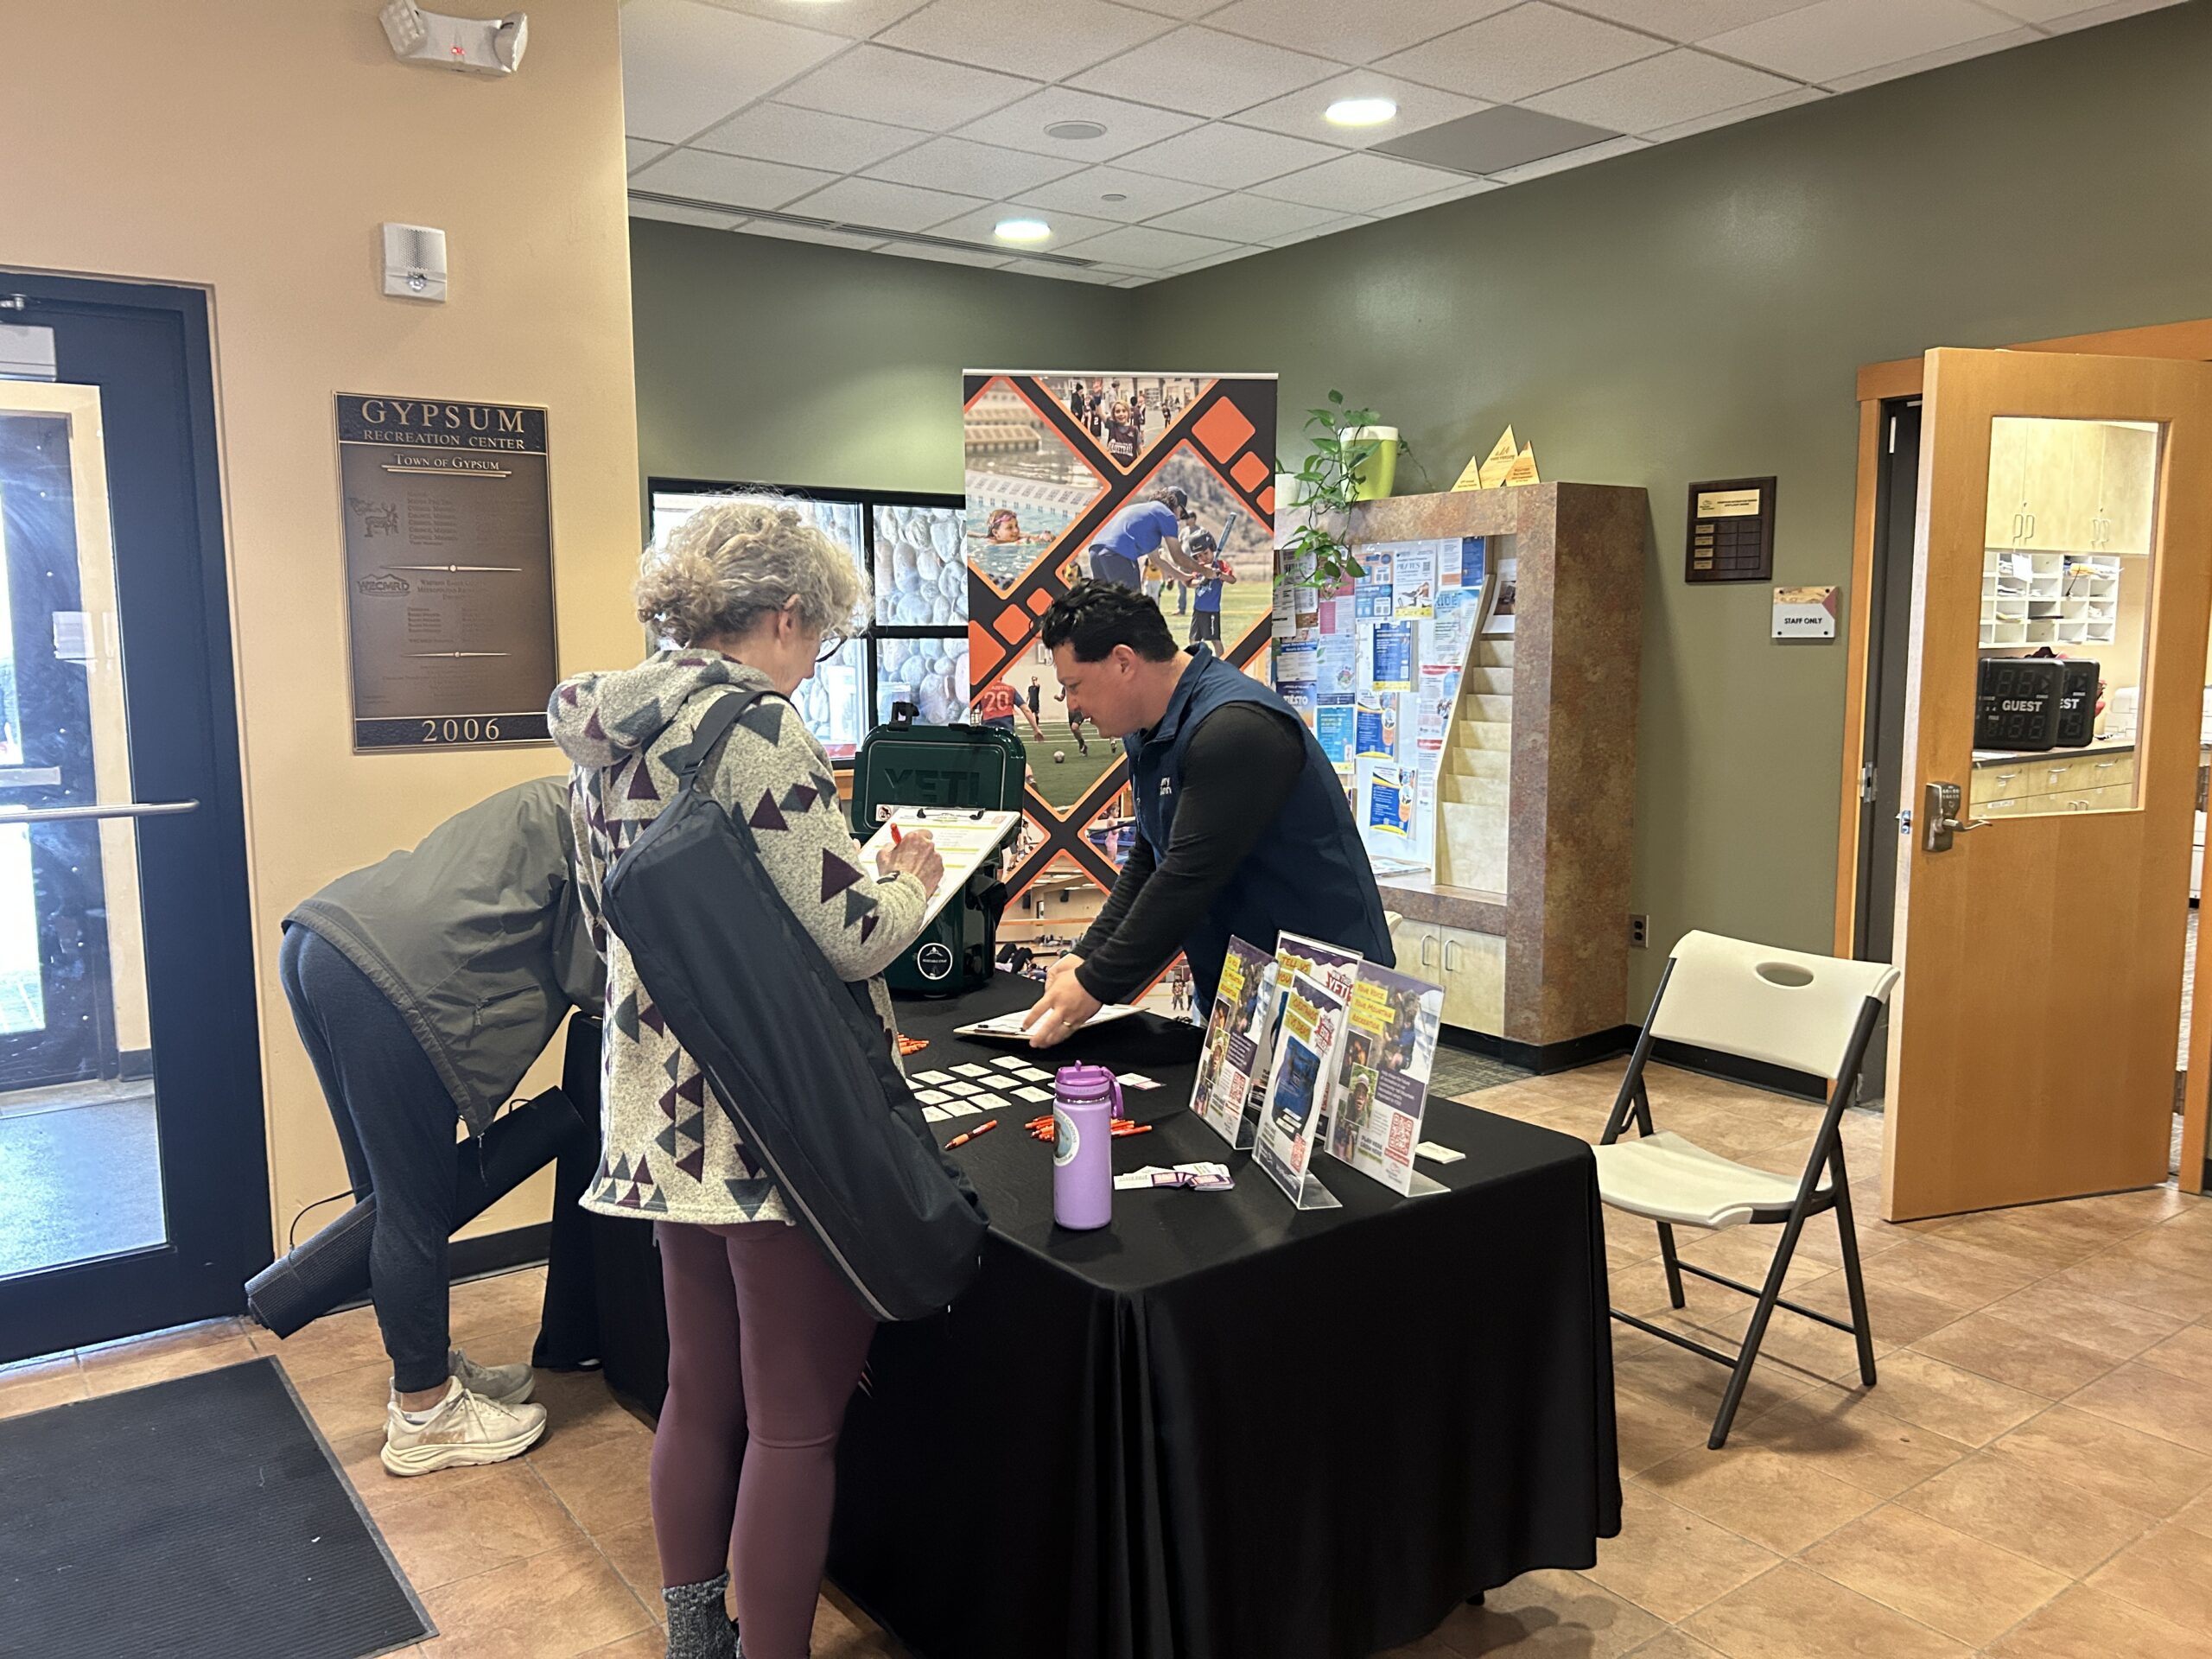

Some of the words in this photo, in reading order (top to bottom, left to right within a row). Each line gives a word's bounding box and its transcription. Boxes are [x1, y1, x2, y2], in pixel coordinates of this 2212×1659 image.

[361, 399, 524, 433] GYPSUM
[364, 429, 461, 445] RECREATION
[469, 436, 525, 450] CENTER
[984, 691, 1009, 712] 20
[2002, 700, 2043, 712] GUEST
[422, 718, 499, 742] 2006
[884, 768, 980, 805] YETI
[1282, 957, 1298, 968] TELL
[1300, 963, 1310, 973] US
[1329, 977, 1350, 1001] YETI
